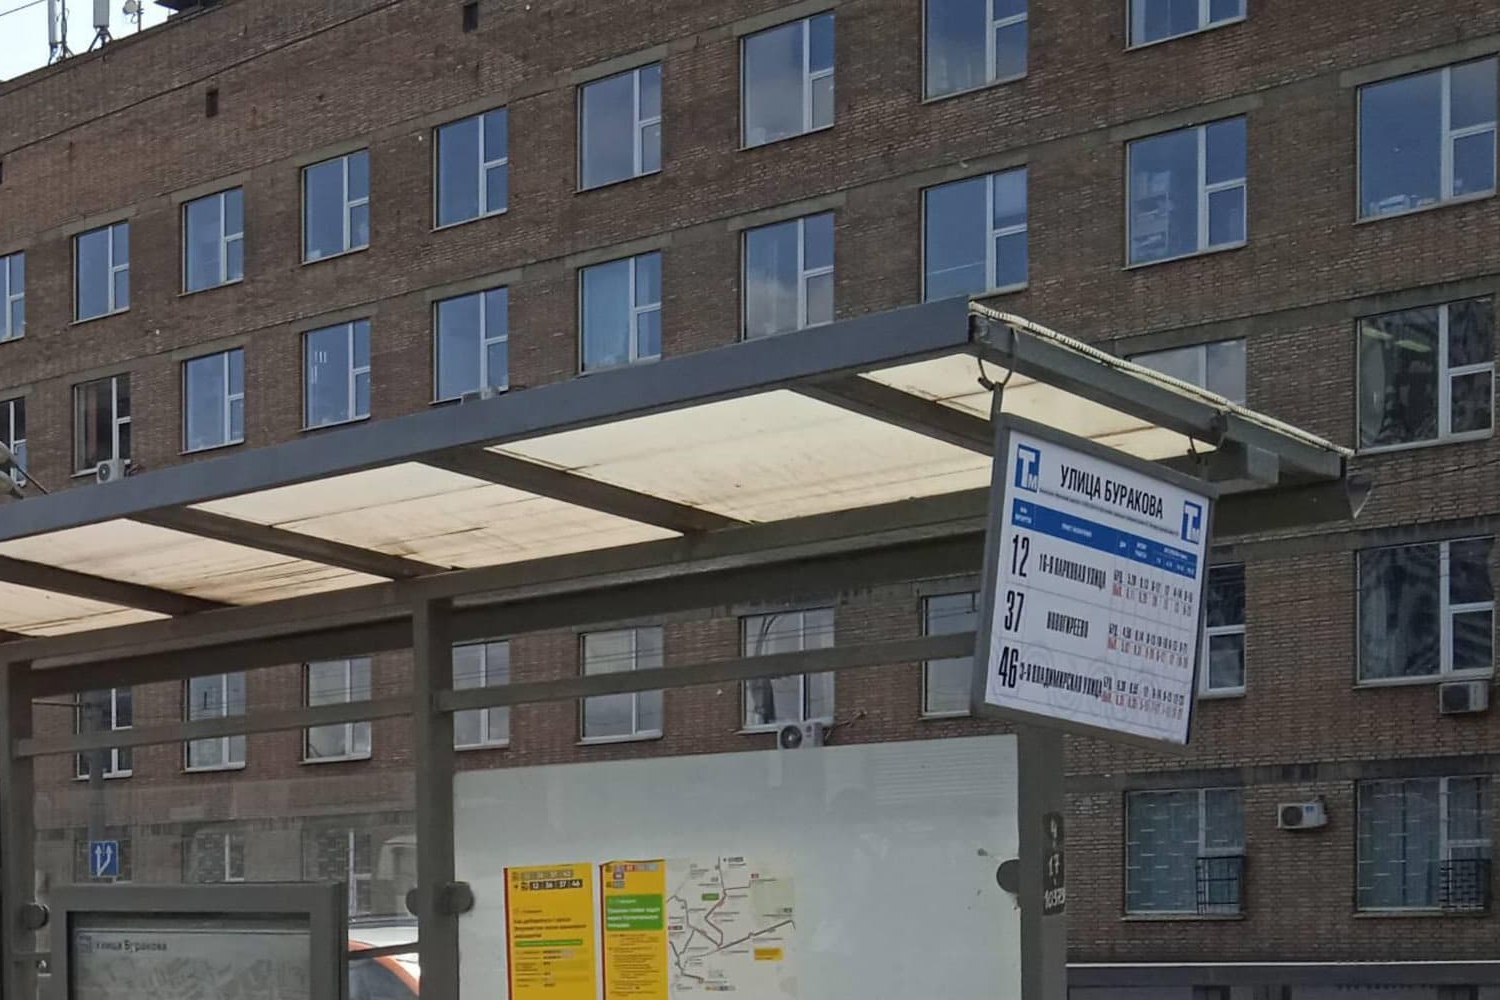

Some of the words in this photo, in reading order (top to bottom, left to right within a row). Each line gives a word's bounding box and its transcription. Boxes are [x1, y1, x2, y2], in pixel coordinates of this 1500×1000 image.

[1060, 464, 1100, 500] УЛИЦА
[1104, 480, 1163, 520] БУРАКОВА
[1012, 534, 1030, 577] 12
[1004, 590, 1024, 633] 37
[998, 646, 1019, 689] 46
